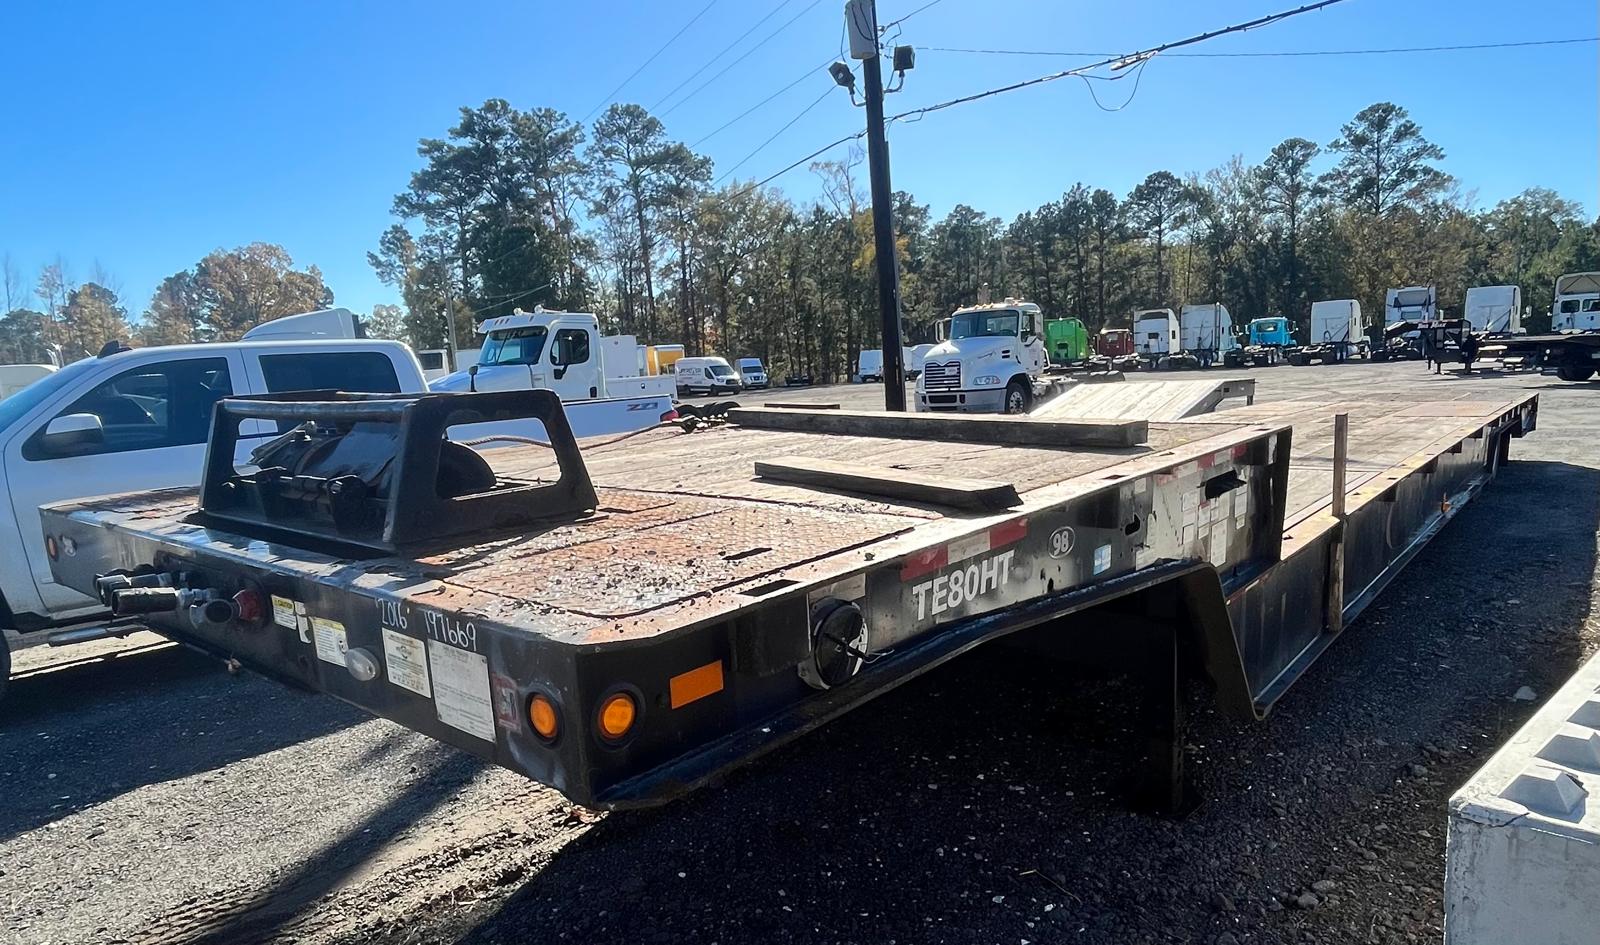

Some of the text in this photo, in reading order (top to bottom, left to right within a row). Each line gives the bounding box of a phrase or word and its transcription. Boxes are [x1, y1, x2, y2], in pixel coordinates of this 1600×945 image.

[1053, 531, 1069, 556] 98
[912, 549, 1015, 621] TE80HT
[378, 598, 407, 629] 2016
[424, 610, 477, 652] 197669
